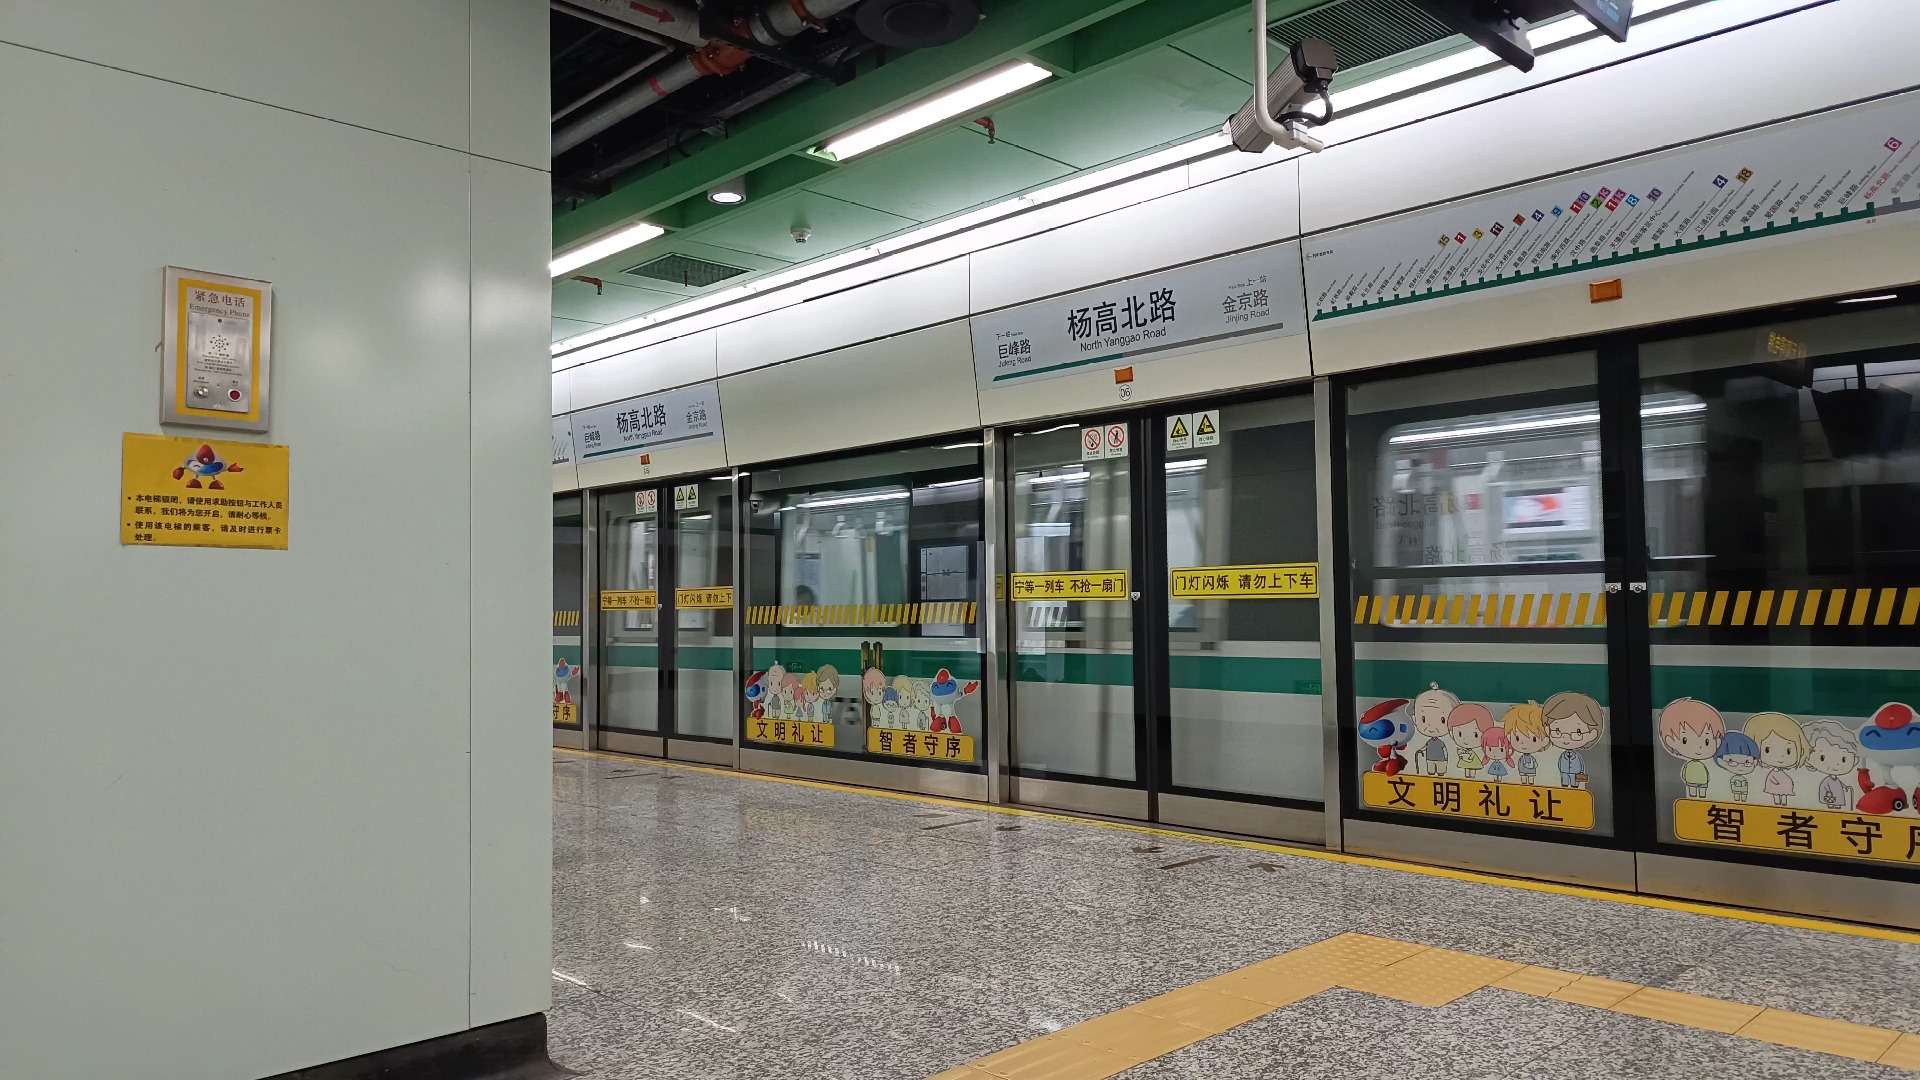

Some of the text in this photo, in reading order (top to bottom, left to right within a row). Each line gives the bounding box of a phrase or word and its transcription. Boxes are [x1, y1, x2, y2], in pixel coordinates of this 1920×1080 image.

[1738, 168, 1752, 181] 18
[1577, 192, 1590, 204] 10
[1598, 188, 1611, 198] 13
[1613, 189, 1626, 201] 13
[1648, 188, 1662, 200] 10
[1438, 234, 1450, 246] 15
[195, 290, 246, 308] 紧急电话
[1222, 288, 1269, 314] 金京路
[189, 303, 250, 318] Emergency Phone
[1067, 288, 1176, 342] 杨高北路
[1226, 308, 1270, 324] Jinjing Road
[1080, 327, 1166, 352] North Yanggao Road
[999, 339, 1032, 359] 巨峰路
[1017, 355, 1032, 364] Road
[616, 403, 666, 434] 杨高北路
[686, 409, 706, 423] 金京路
[585, 430, 600, 443] 巨峰路
[1014, 578, 1123, 594] 宁等一列车 不抢一扇门
[1175, 571, 1314, 591] 门灯闪烁 请勿上下车
[602, 596, 626, 605] 宁等一列车
[677, 593, 702, 604] 门灯闪烁
[756, 720, 824, 744] 文明礼让
[879, 729, 962, 759] 智者守序
[1386, 777, 1565, 822] 文明礼让
